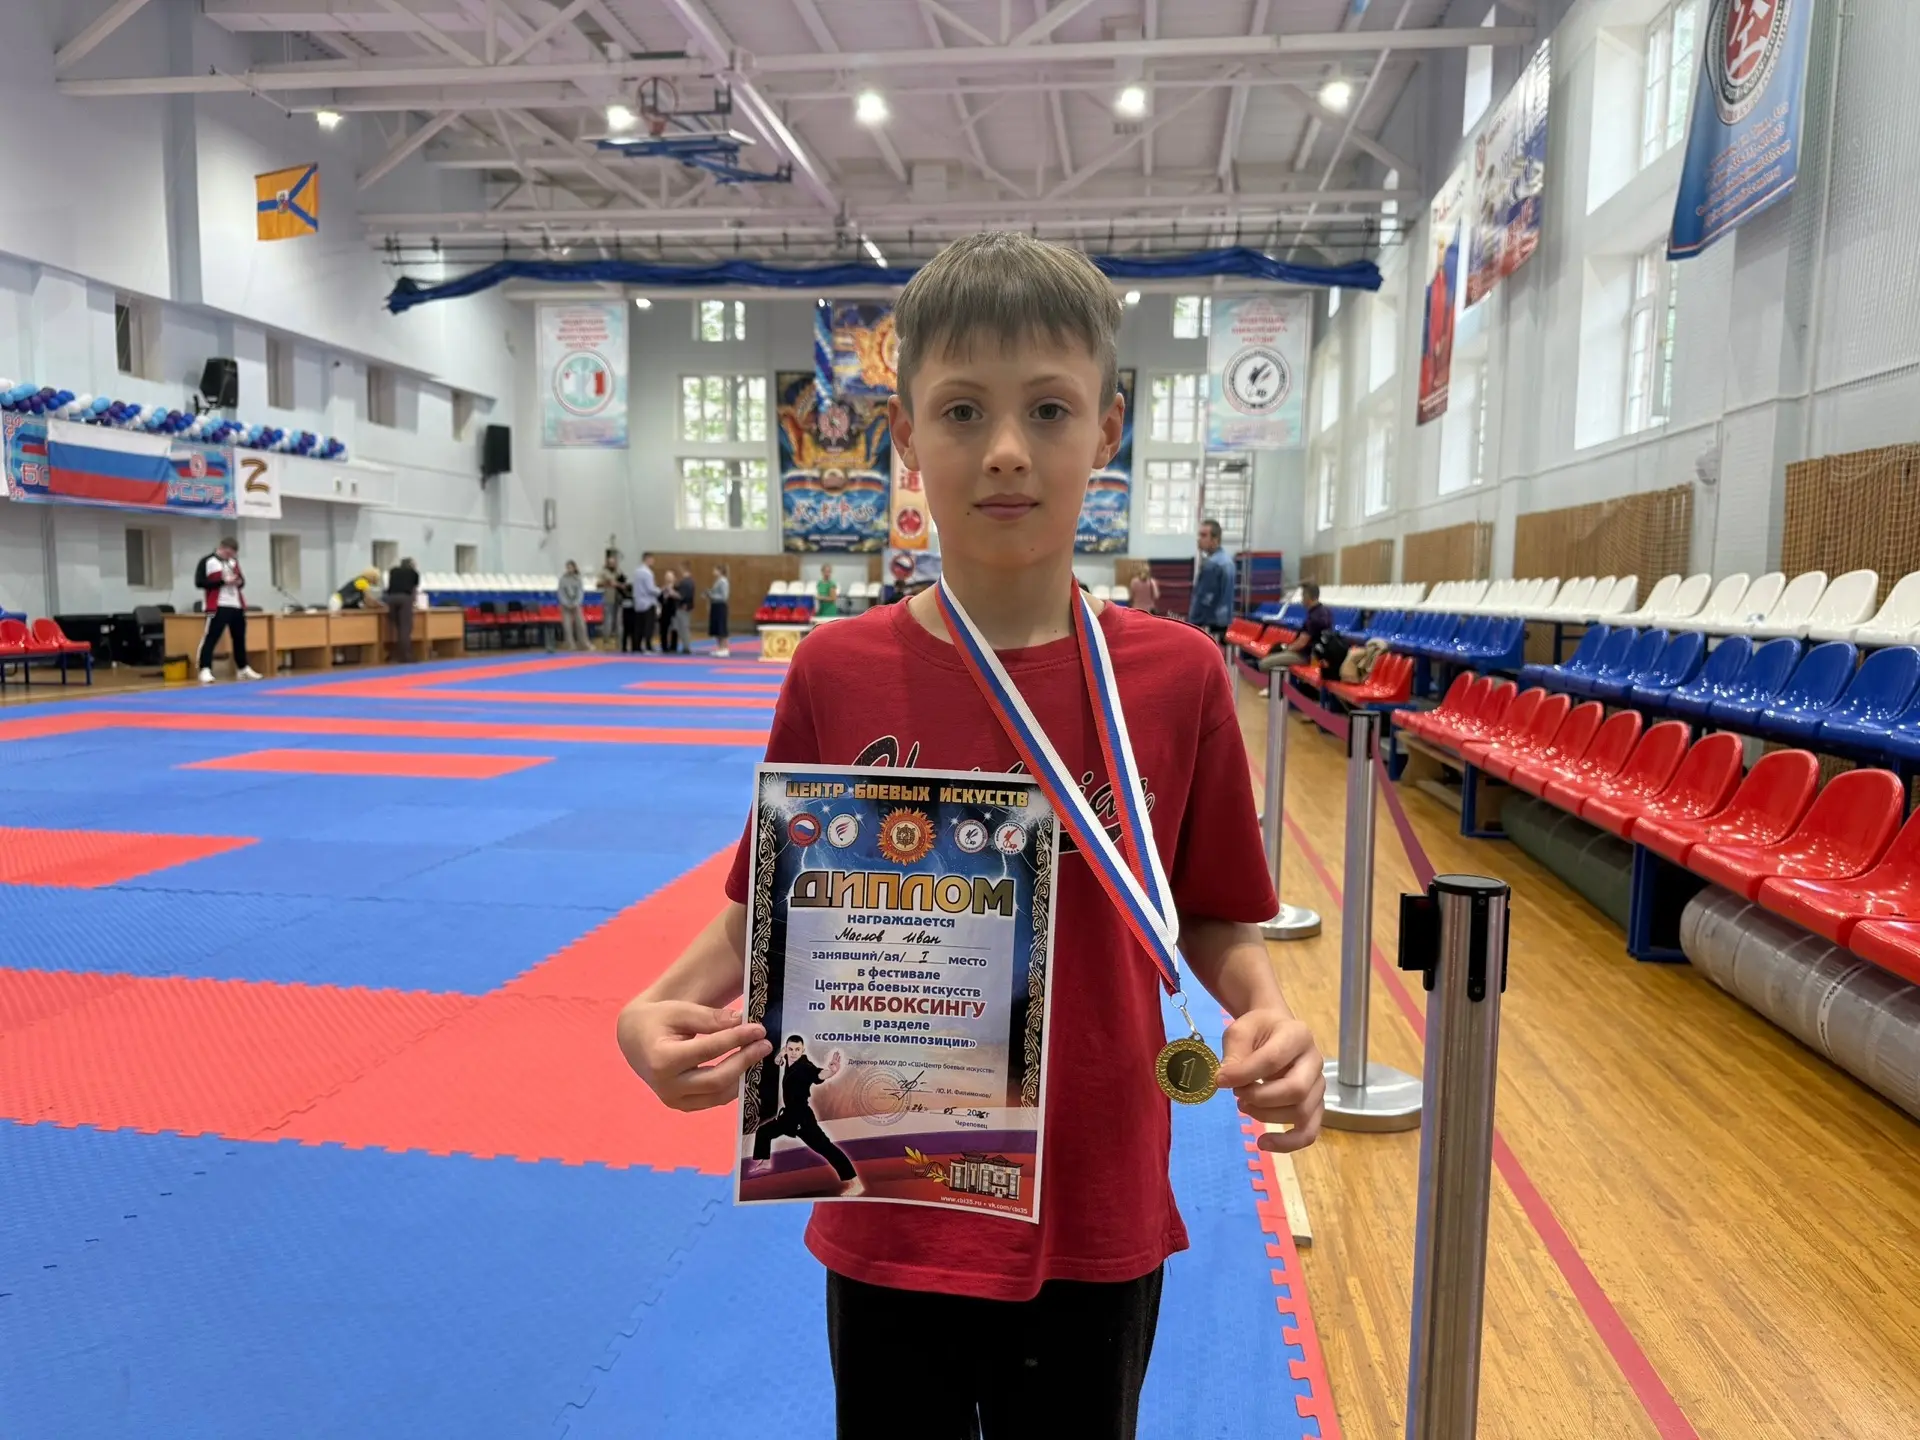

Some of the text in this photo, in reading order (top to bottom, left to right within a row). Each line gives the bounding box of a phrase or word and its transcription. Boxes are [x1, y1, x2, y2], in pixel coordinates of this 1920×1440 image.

[777, 638, 788, 653] 2
[786, 781, 1029, 807] ЦЕНТР БОЕВЫХ ИСКУССТВ
[791, 871, 1015, 917] ДИПЛОМ
[847, 913, 955, 928] награждается
[835, 928, 884, 943] Маслов
[948, 956, 987, 968] место
[858, 968, 940, 981] в фестивале
[814, 979, 981, 999] Центра боевых искусств
[809, 995, 986, 1018] по КИКБОКСИНГУ
[863, 1019, 930, 1031] в разделе
[814, 1031, 977, 1049] «сольные композиции»
[1178, 1058, 1196, 1088] 1
[955, 1120, 988, 1129] Череповец
[940, 1196, 1028, 1214] www.cbi35.ru vk.com/cbi35
